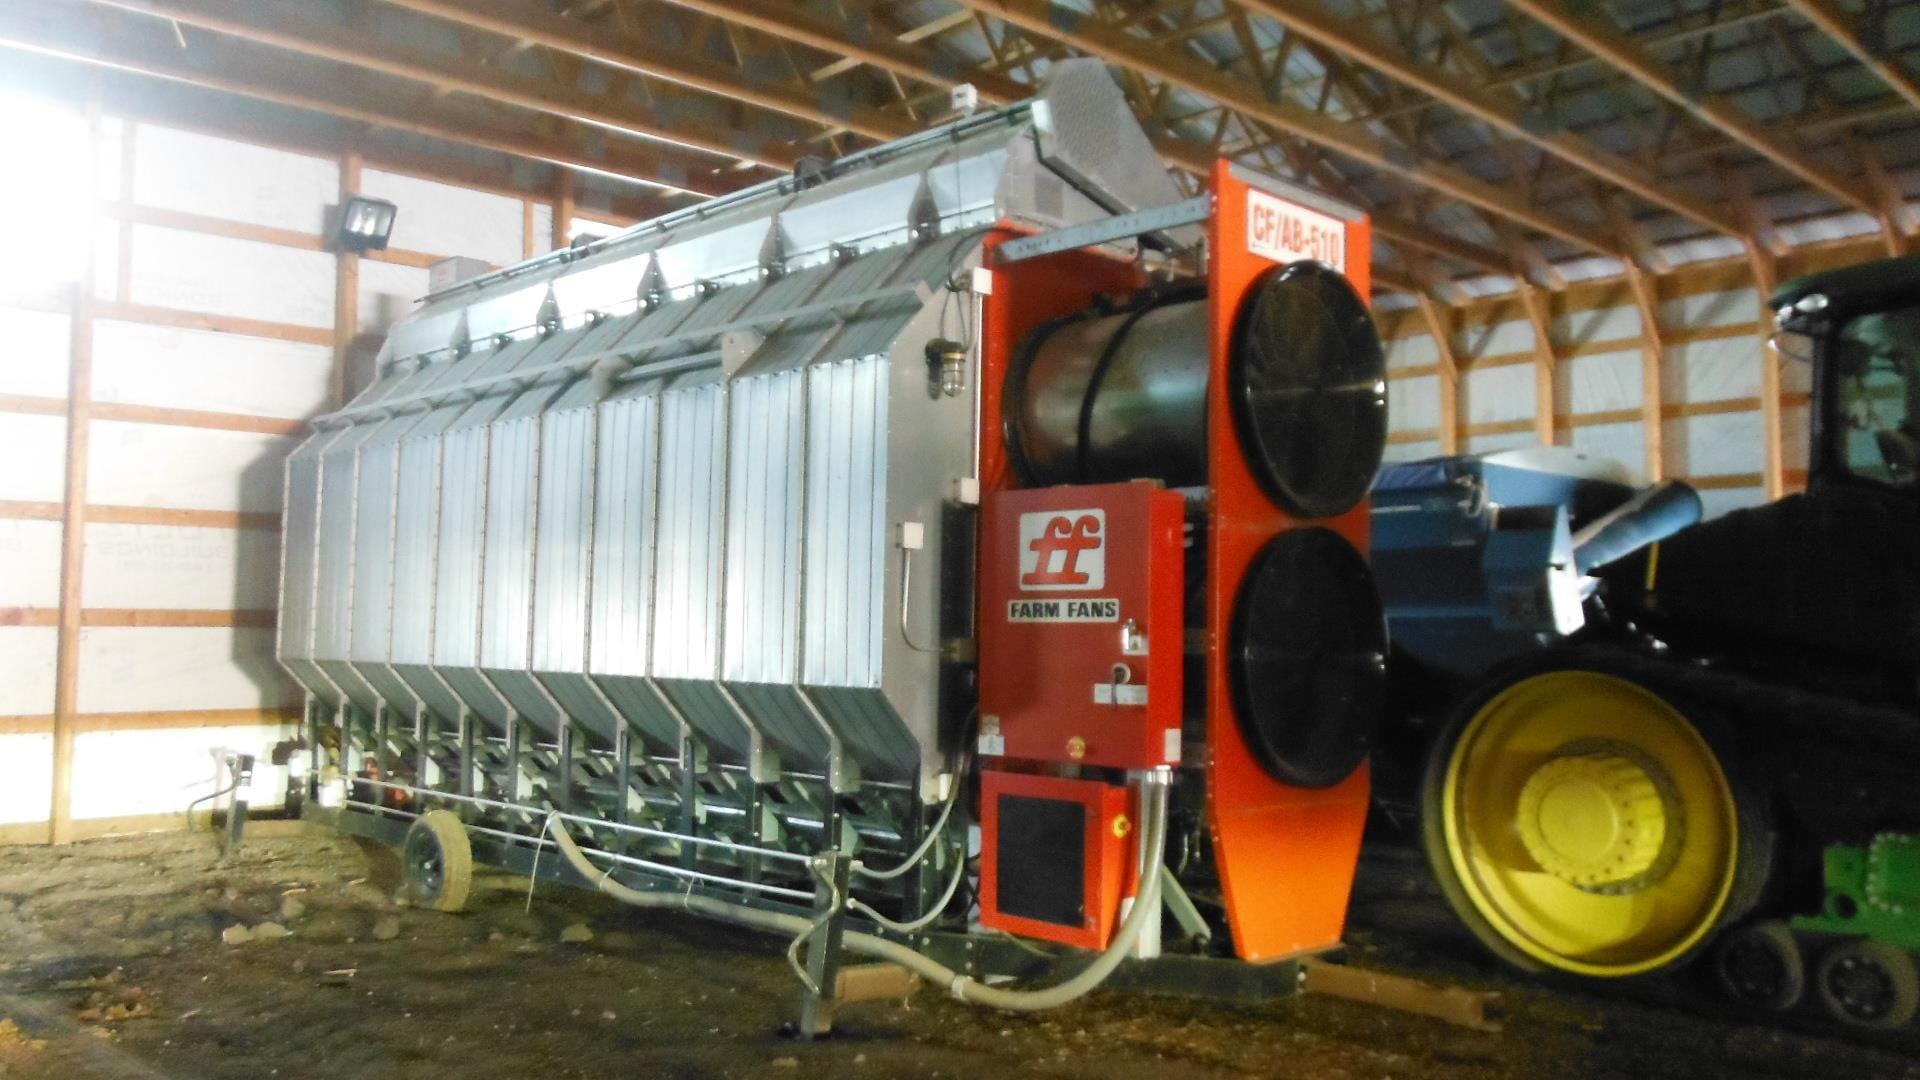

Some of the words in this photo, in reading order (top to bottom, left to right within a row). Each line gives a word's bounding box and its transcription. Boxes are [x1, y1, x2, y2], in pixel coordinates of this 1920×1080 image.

[1253, 203, 1339, 266] CF/AB-510
[1022, 515, 1102, 586] ff
[1011, 602, 1060, 618] FARM
[1068, 601, 1116, 618] FANS
